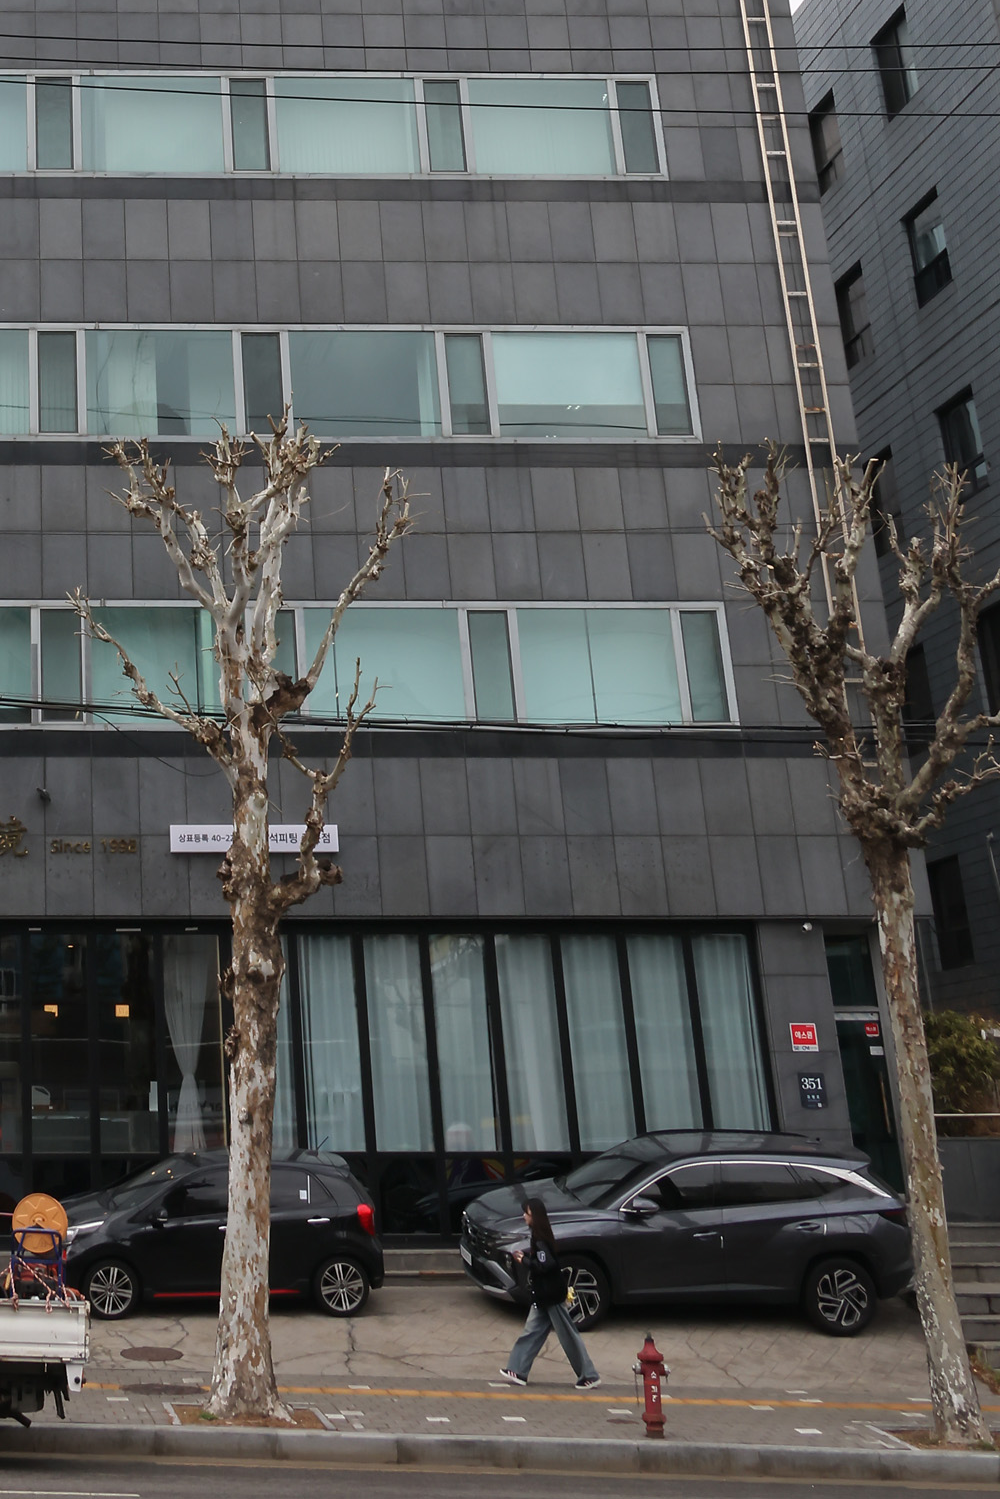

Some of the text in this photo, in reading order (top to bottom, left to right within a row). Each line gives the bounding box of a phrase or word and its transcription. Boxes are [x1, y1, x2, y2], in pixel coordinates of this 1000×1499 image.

[178, 833, 209, 843] 상표등록
[211, 834, 234, 843] 40-22
[269, 833, 298, 844] 석피팅
[50, 838, 91, 854] Since
[801, 1077, 823, 1090] 351
